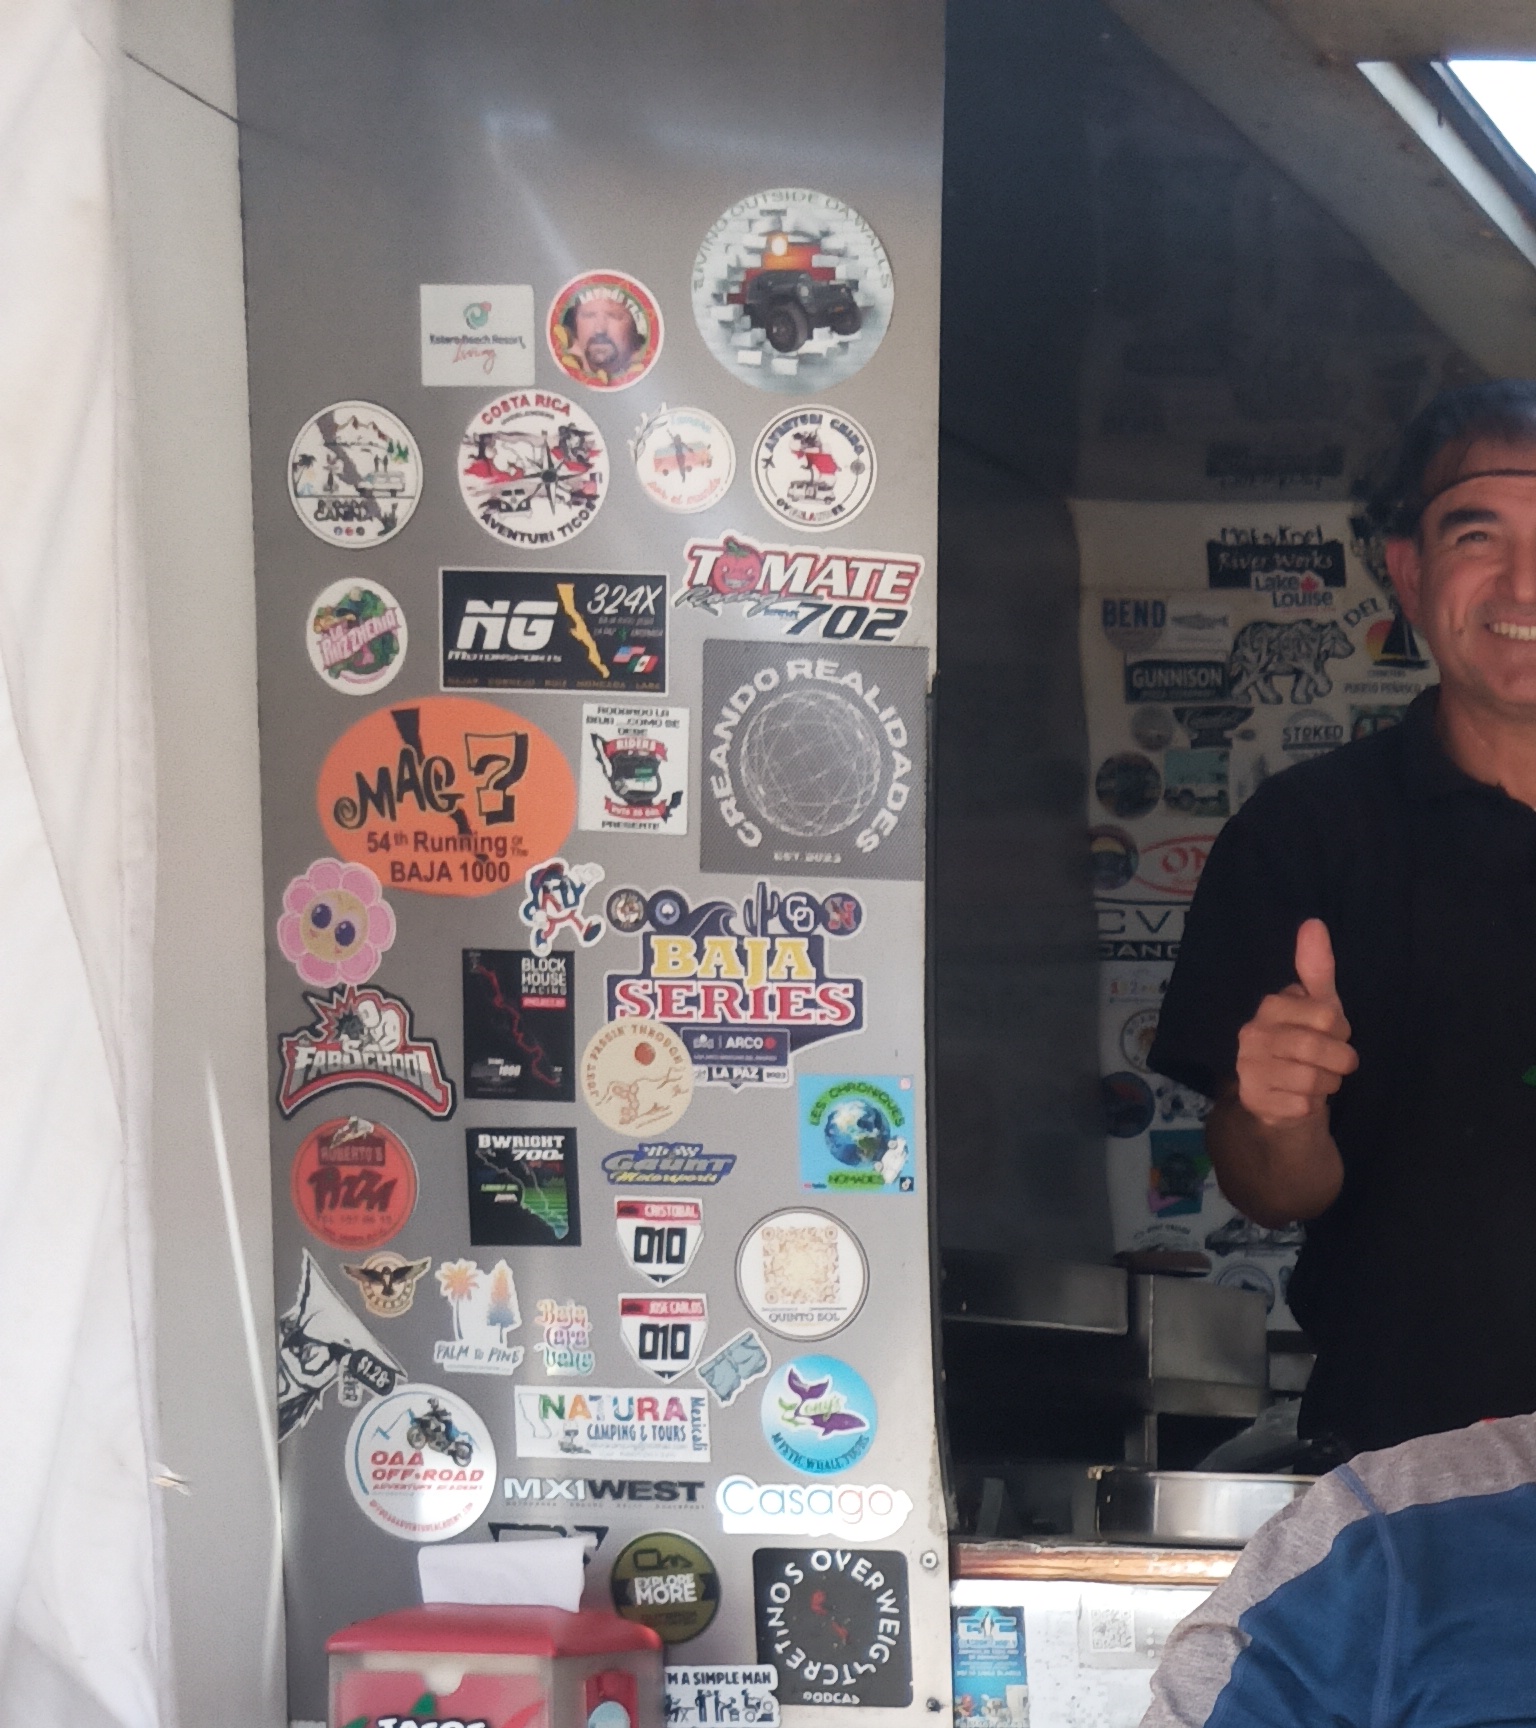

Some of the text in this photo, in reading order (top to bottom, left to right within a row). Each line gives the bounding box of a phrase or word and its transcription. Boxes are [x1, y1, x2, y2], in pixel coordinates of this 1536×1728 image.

[1255, 574, 1299, 592] Lake
[587, 582, 663, 616] 324X
[1272, 590, 1334, 609] Louise
[456, 600, 559, 651] NG
[786, 602, 909, 642] 702
[1102, 600, 1167, 629] BEND
[1131, 667, 1224, 689] GUNNISON
[1282, 724, 1344, 743] STOKED
[710, 657, 912, 853] CREANDO REALIDADES
[413, 831, 508, 858] Running
[390, 861, 511, 883] BAJA 1000
[521, 957, 566, 972] BLOCK
[650, 935, 816, 987] BAJA
[521, 972, 567, 986] HOUSE
[615, 980, 855, 1025] SERIES
[726, 1037, 764, 1050] ARCO
[733, 1068, 759, 1080] PAZ
[478, 1134, 566, 1149] BWRIGHT
[643, 1204, 699, 1219] CRISTOBAL
[634, 1226, 688, 1264] 010
[639, 1323, 692, 1361] 010
[541, 1394, 689, 1423] NATURA
[587, 1423, 688, 1443] CAMPING TOURS
[721, 1480, 894, 1525] Casago
[634, 1573, 696, 1590] EXPLORE
[635, 1585, 698, 1606] MORE
[694, 1672, 740, 1686] SIMPLE
[742, 1672, 772, 1686] MAN
